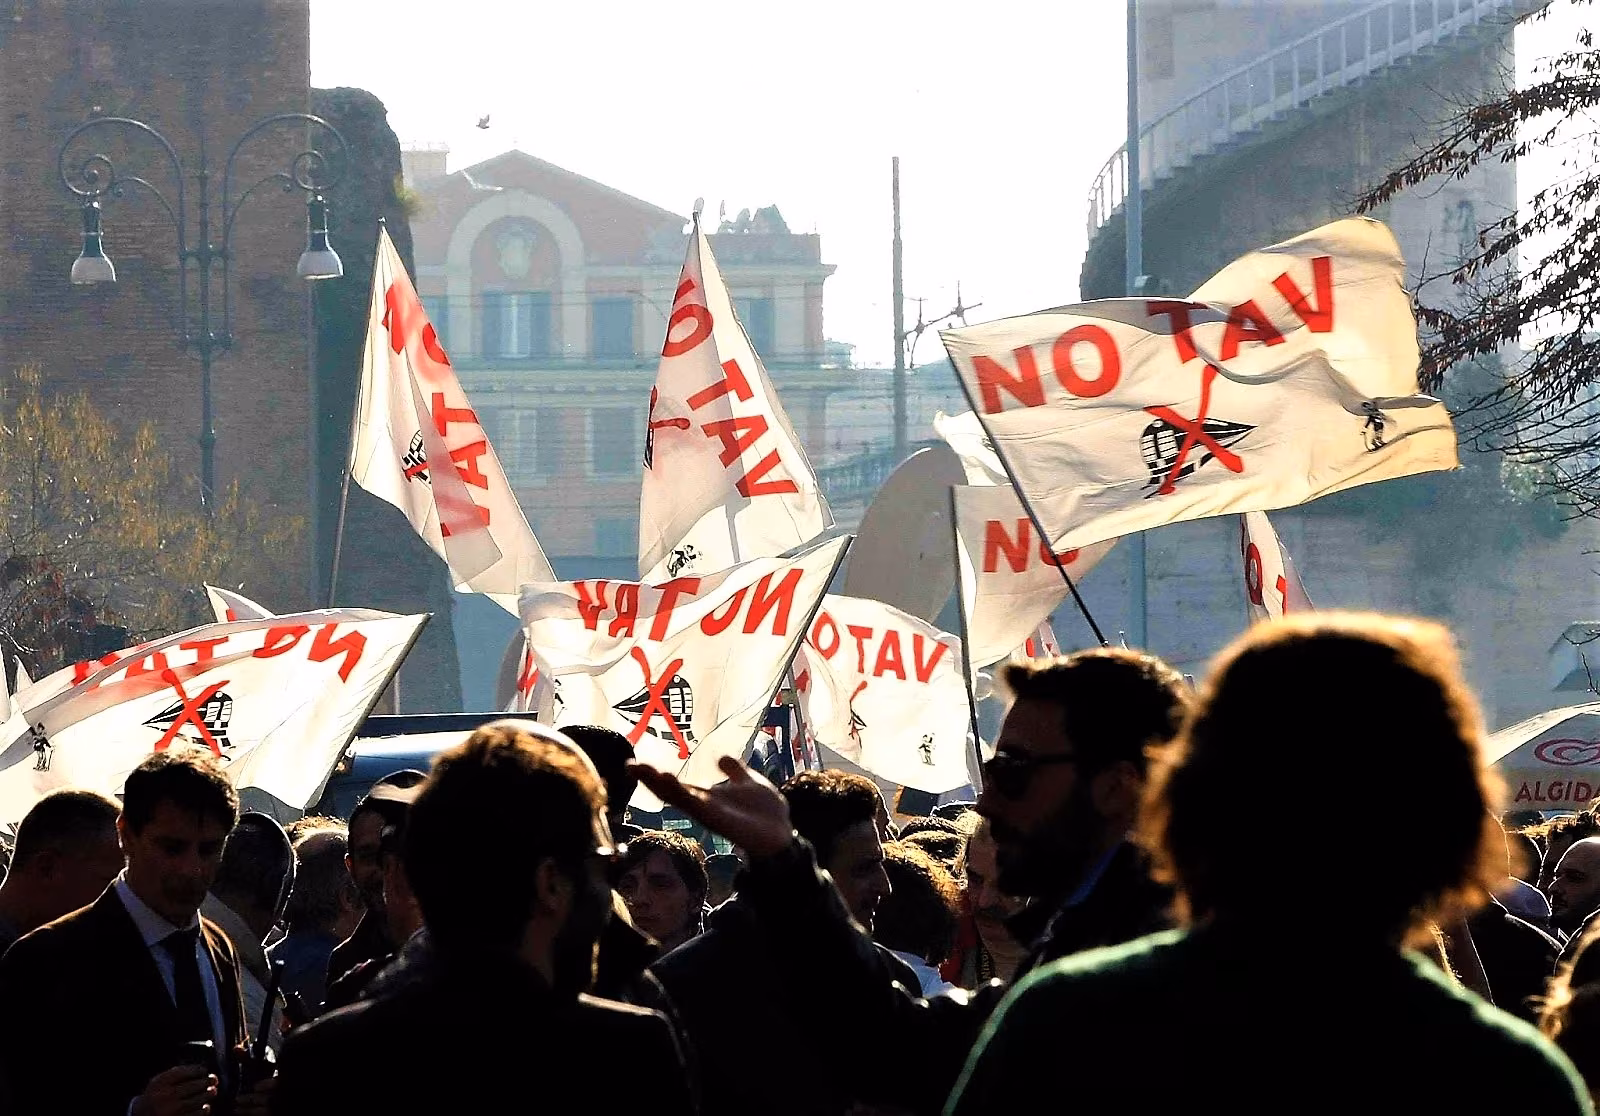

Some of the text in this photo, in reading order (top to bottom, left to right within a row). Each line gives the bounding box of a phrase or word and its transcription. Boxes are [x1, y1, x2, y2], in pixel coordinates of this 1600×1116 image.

[661, 277, 799, 498] O TAV
[970, 255, 1335, 415] NO TAV
[846, 624, 949, 684] TAV
